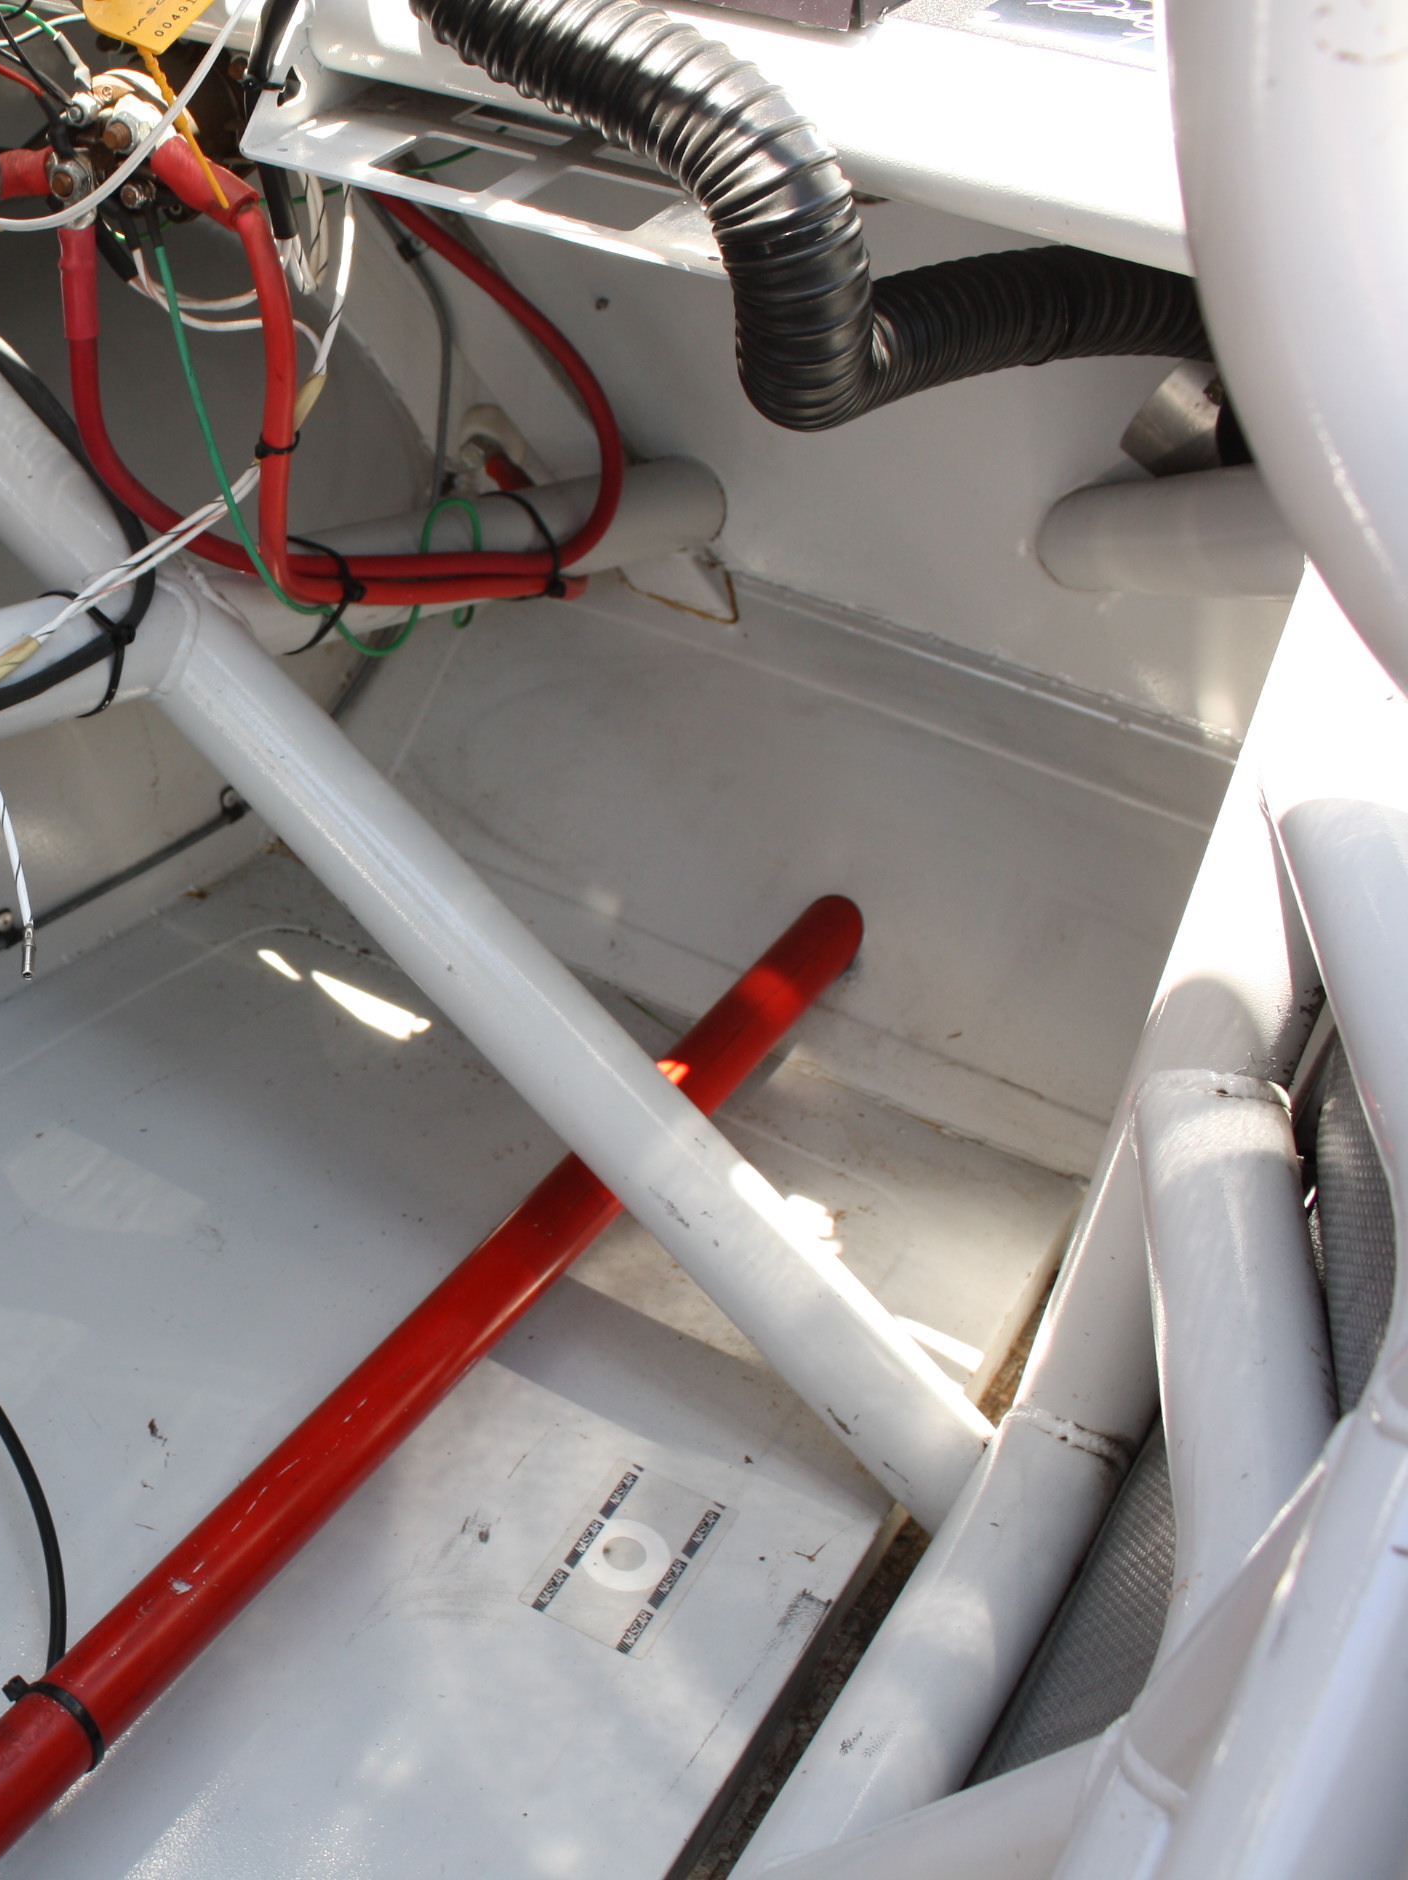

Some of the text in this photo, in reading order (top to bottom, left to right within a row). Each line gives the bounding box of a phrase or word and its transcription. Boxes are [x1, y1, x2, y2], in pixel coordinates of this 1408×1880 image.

[538, 1473, 637, 1603] NASCAR NASCAR NASCAR
[622, 1511, 719, 1647] NASCAR NASCAR NASCAR
